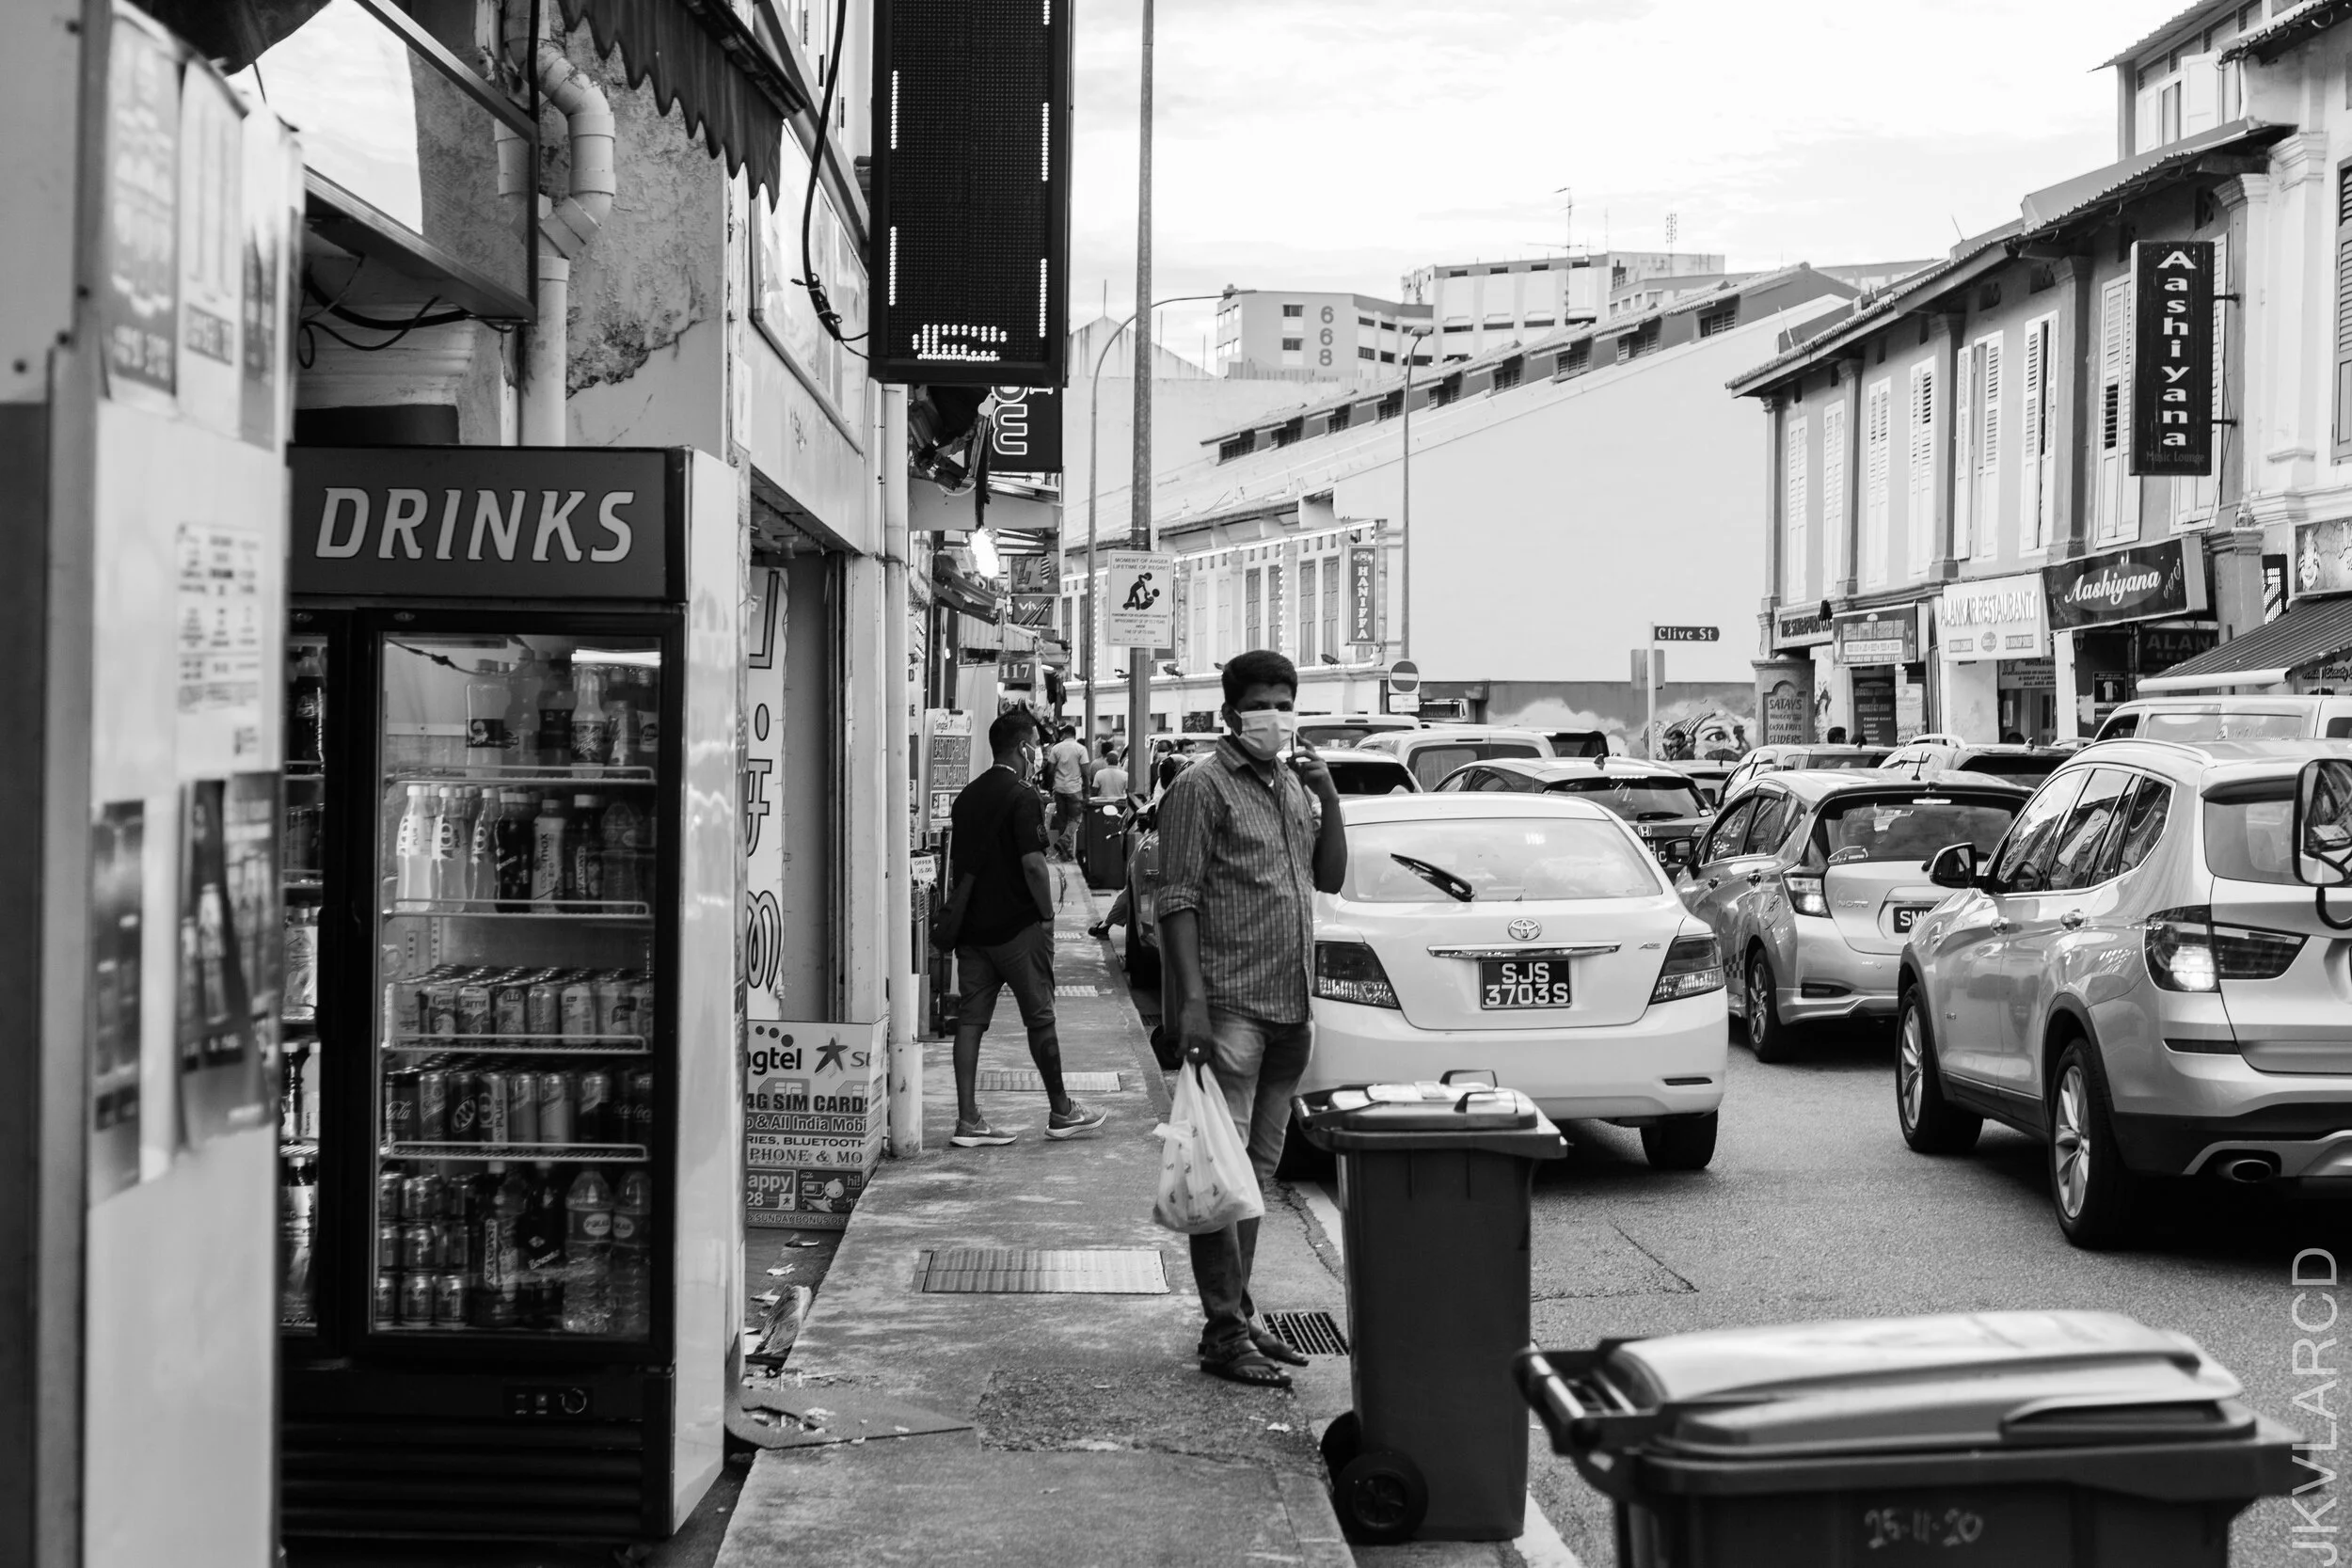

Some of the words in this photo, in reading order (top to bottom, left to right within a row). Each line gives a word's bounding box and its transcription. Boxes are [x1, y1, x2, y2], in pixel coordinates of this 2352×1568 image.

[2156, 250, 2198, 447] Aashiyana
[2173, 451, 2205, 466] Lounge
[314, 486, 637, 562] DRINKS
[2064, 568, 2162, 606] Aashiyana
[1357, 565, 1370, 640] HANIFFA
[1940, 597, 1977, 627] ALANKAR
[1978, 590, 2037, 626] RESTAURANT
[1658, 627, 1693, 641] Clive
[1699, 627, 1713, 641] St
[2145, 633, 2219, 651] ALAN
[1001, 663, 1031, 679] 117
[1769, 698, 1803, 710] SATAYS
[1769, 735, 1802, 745] SLIDERS
[1836, 899, 1869, 908] NOTE
[1899, 911, 1930, 927] SM
[1501, 961, 1550, 984] SJS
[1485, 983, 1568, 1005] 3703S
[773, 1093, 808, 1111] SIM
[756, 1116, 768, 1129] &
[771, 1116, 789, 1130] All
[793, 1117, 829, 1131] India
[750, 1148, 810, 1162] PHONE
[816, 1149, 828, 1163] &
[748, 1174, 791, 1193] appy
[747, 1191, 764, 1207] 28
